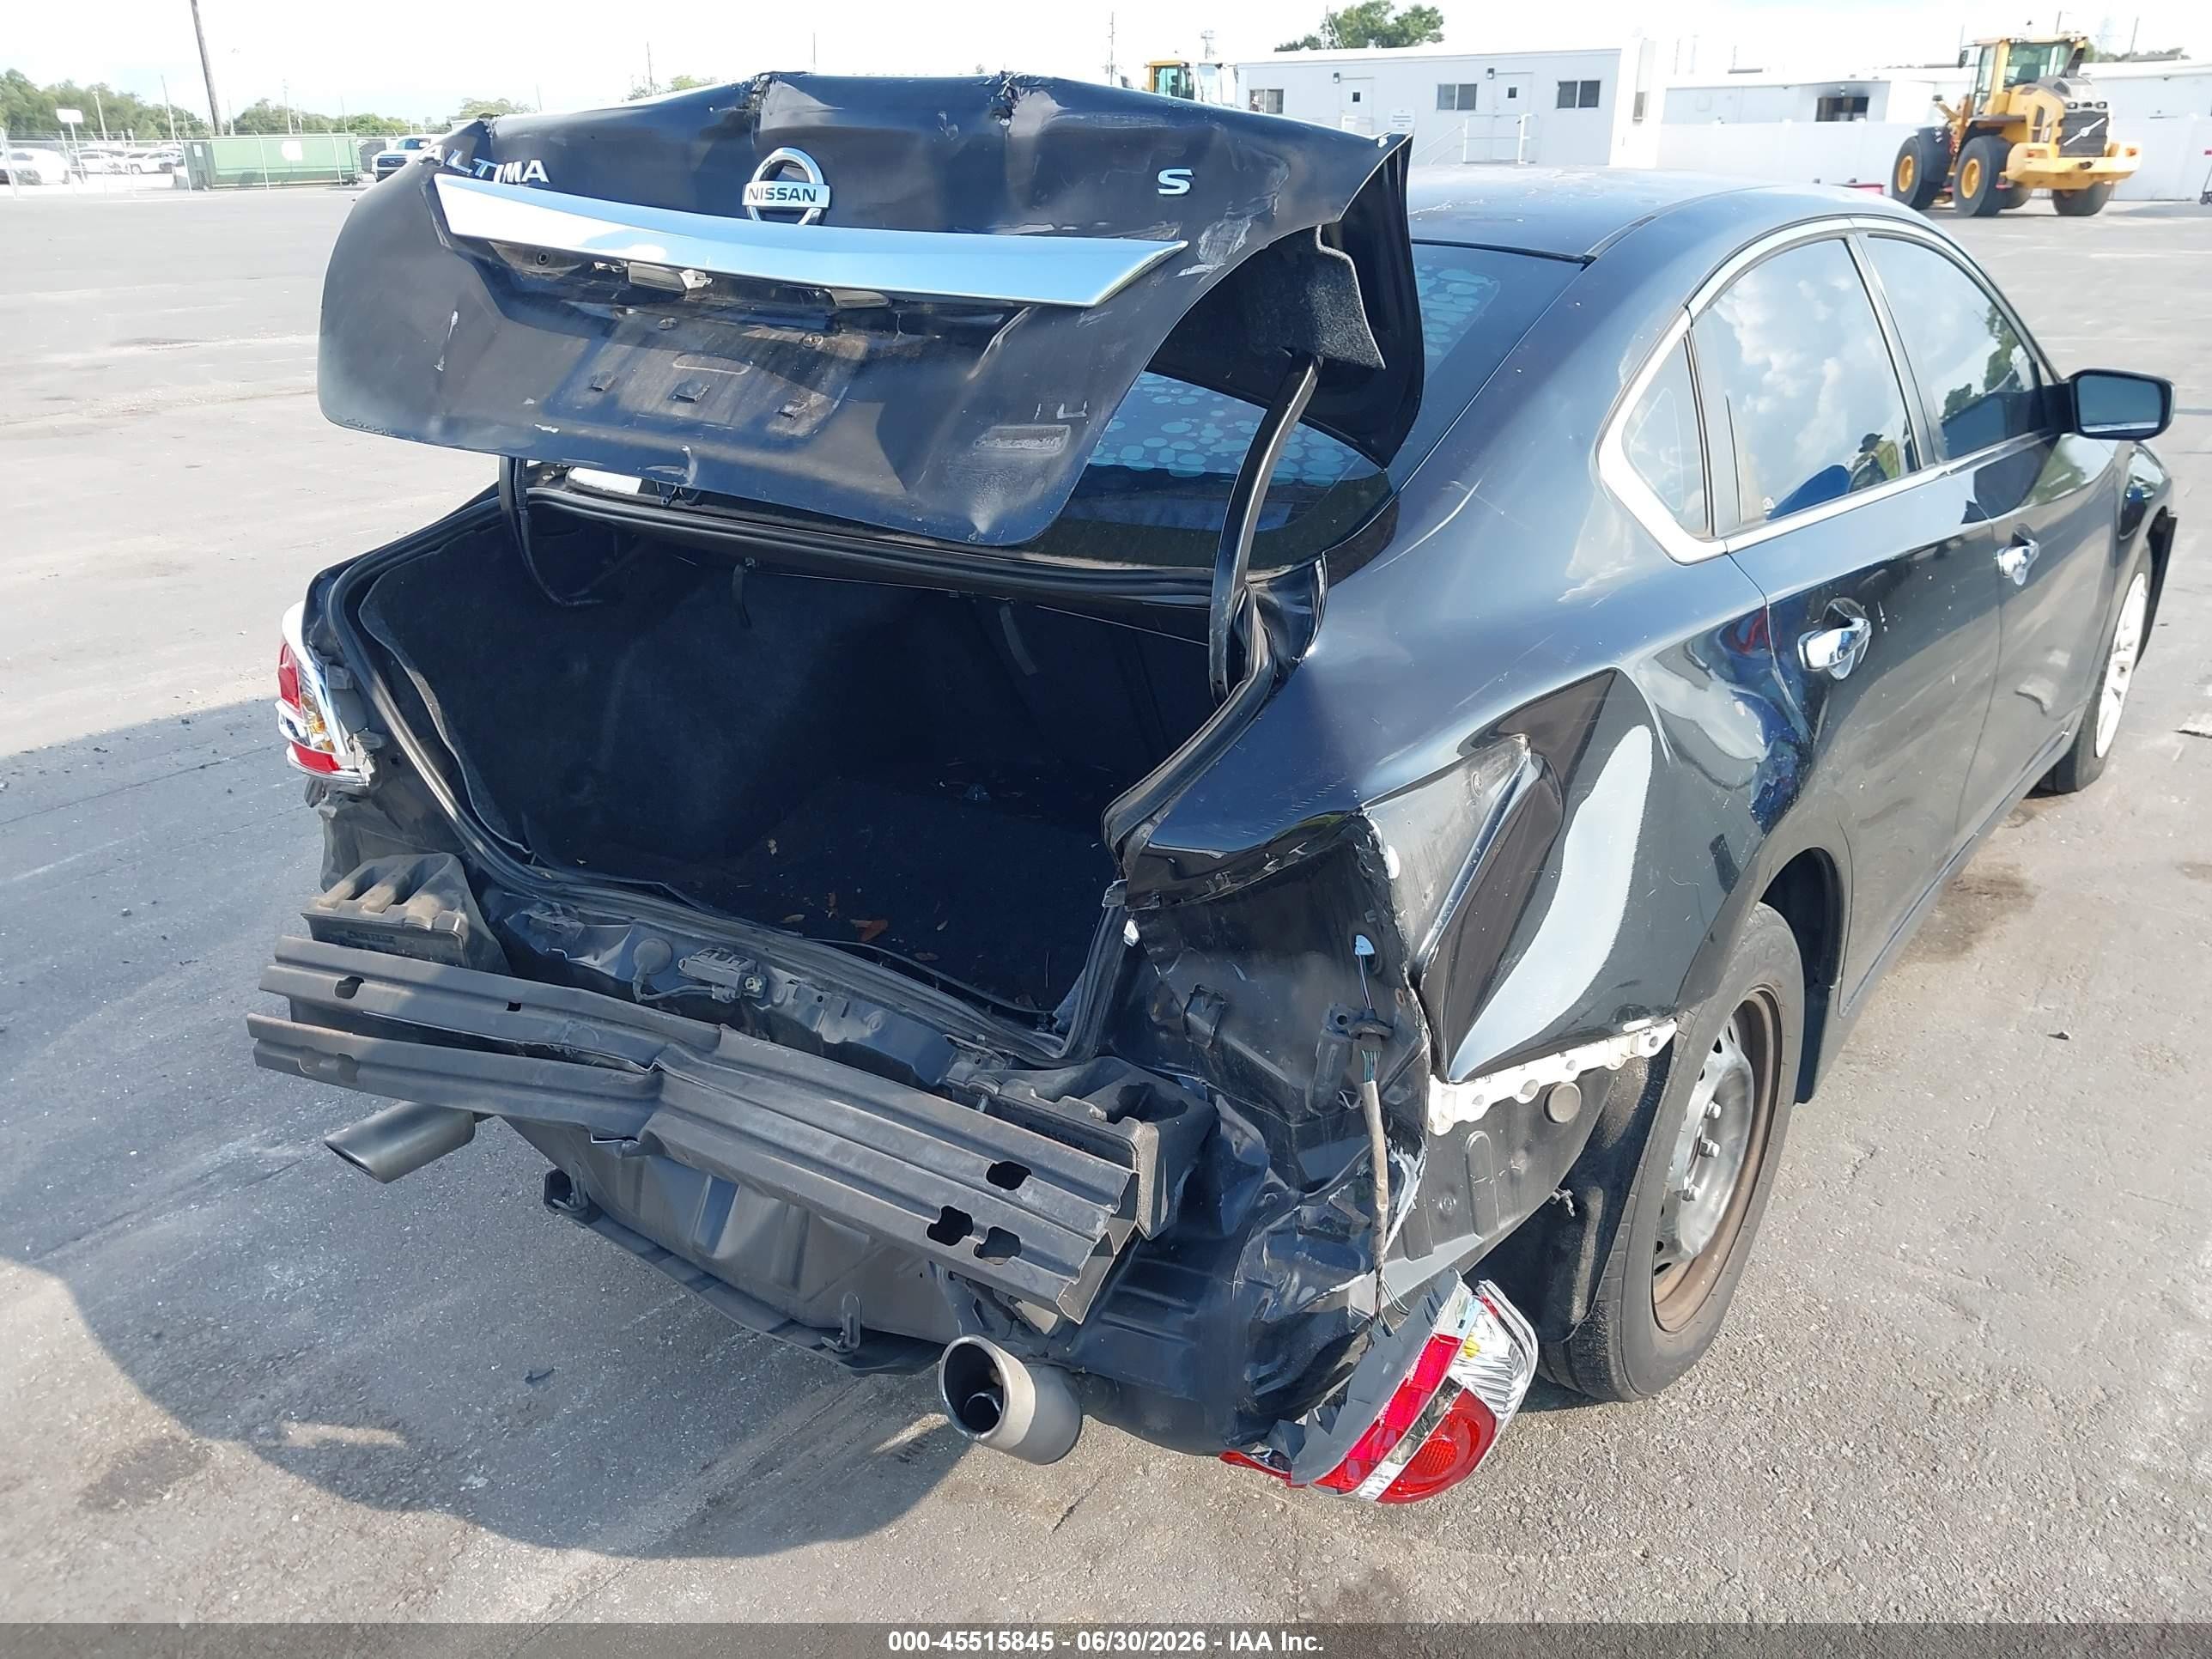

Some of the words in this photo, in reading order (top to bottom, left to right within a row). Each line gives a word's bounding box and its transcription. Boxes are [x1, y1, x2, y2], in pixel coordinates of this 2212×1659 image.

[418, 144, 550, 184] ALTIMA
[748, 187, 817, 203] NISSAN
[1158, 168, 1193, 195] S
